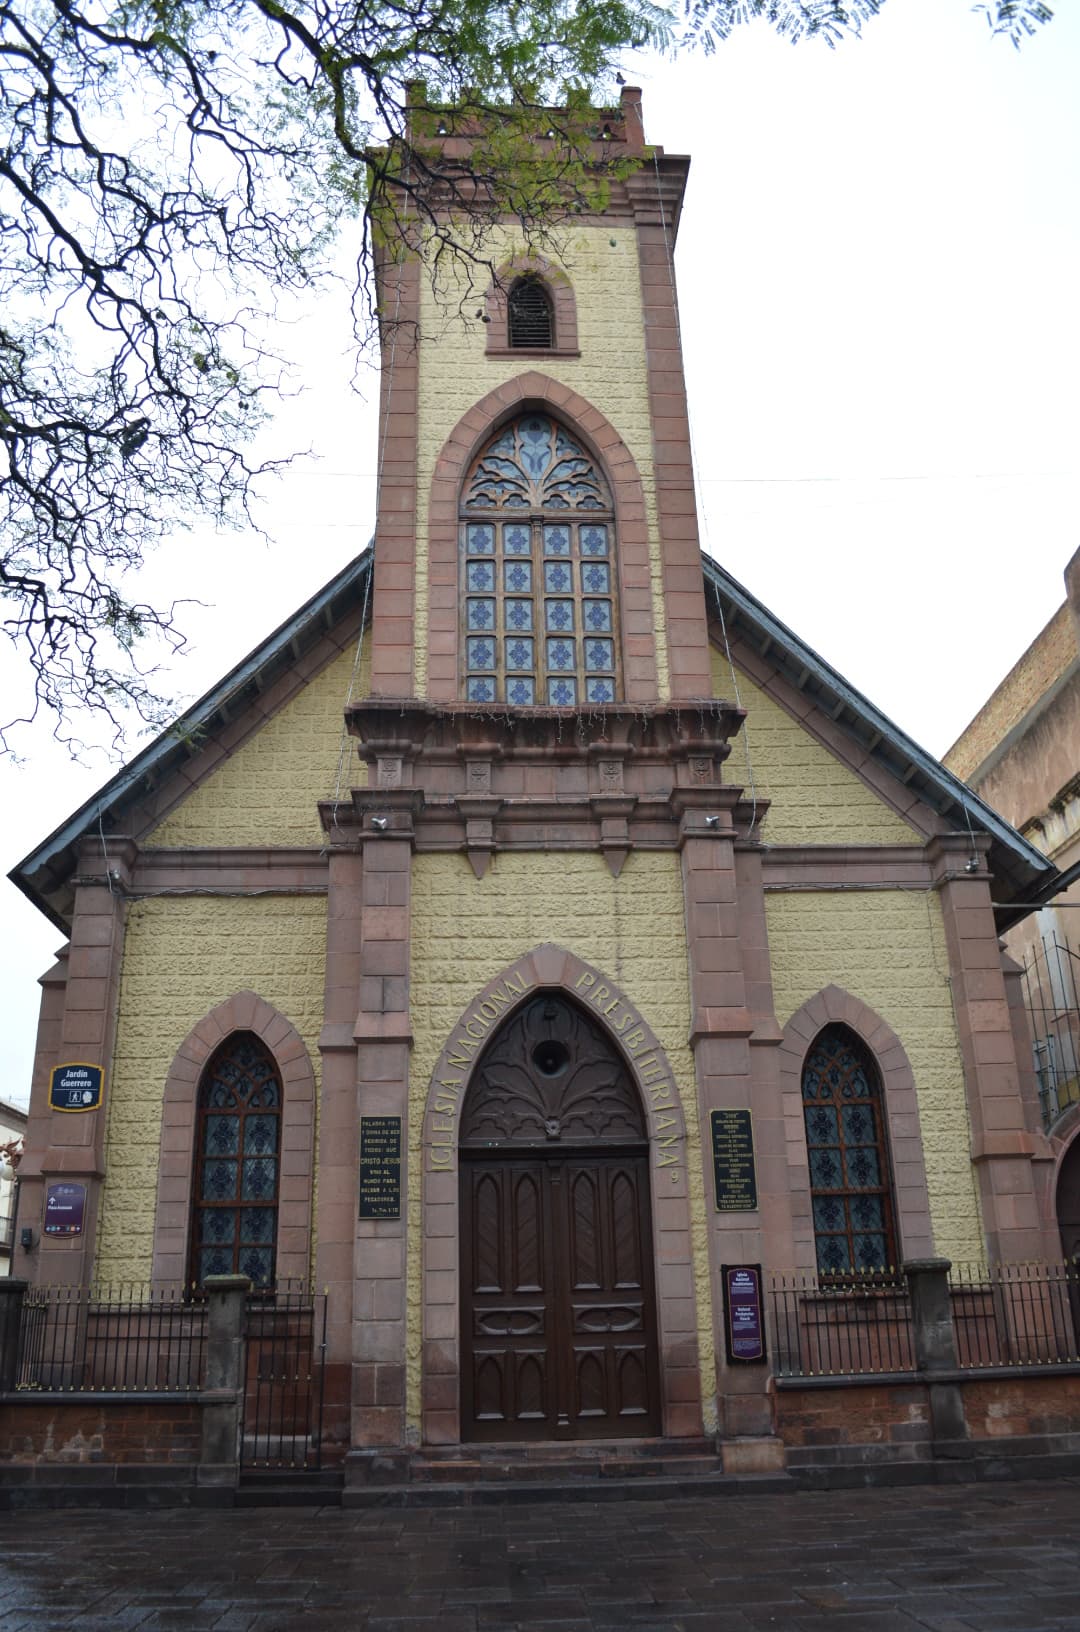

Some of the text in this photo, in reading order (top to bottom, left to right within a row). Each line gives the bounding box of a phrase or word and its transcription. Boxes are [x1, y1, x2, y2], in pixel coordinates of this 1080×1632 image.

[60, 1079, 92, 1087] Guerrero
[430, 1078, 462, 1171] IGLESIA
[447, 971, 533, 1071] NACIONAL
[575, 971, 680, 1168] PRESBITERIANA
